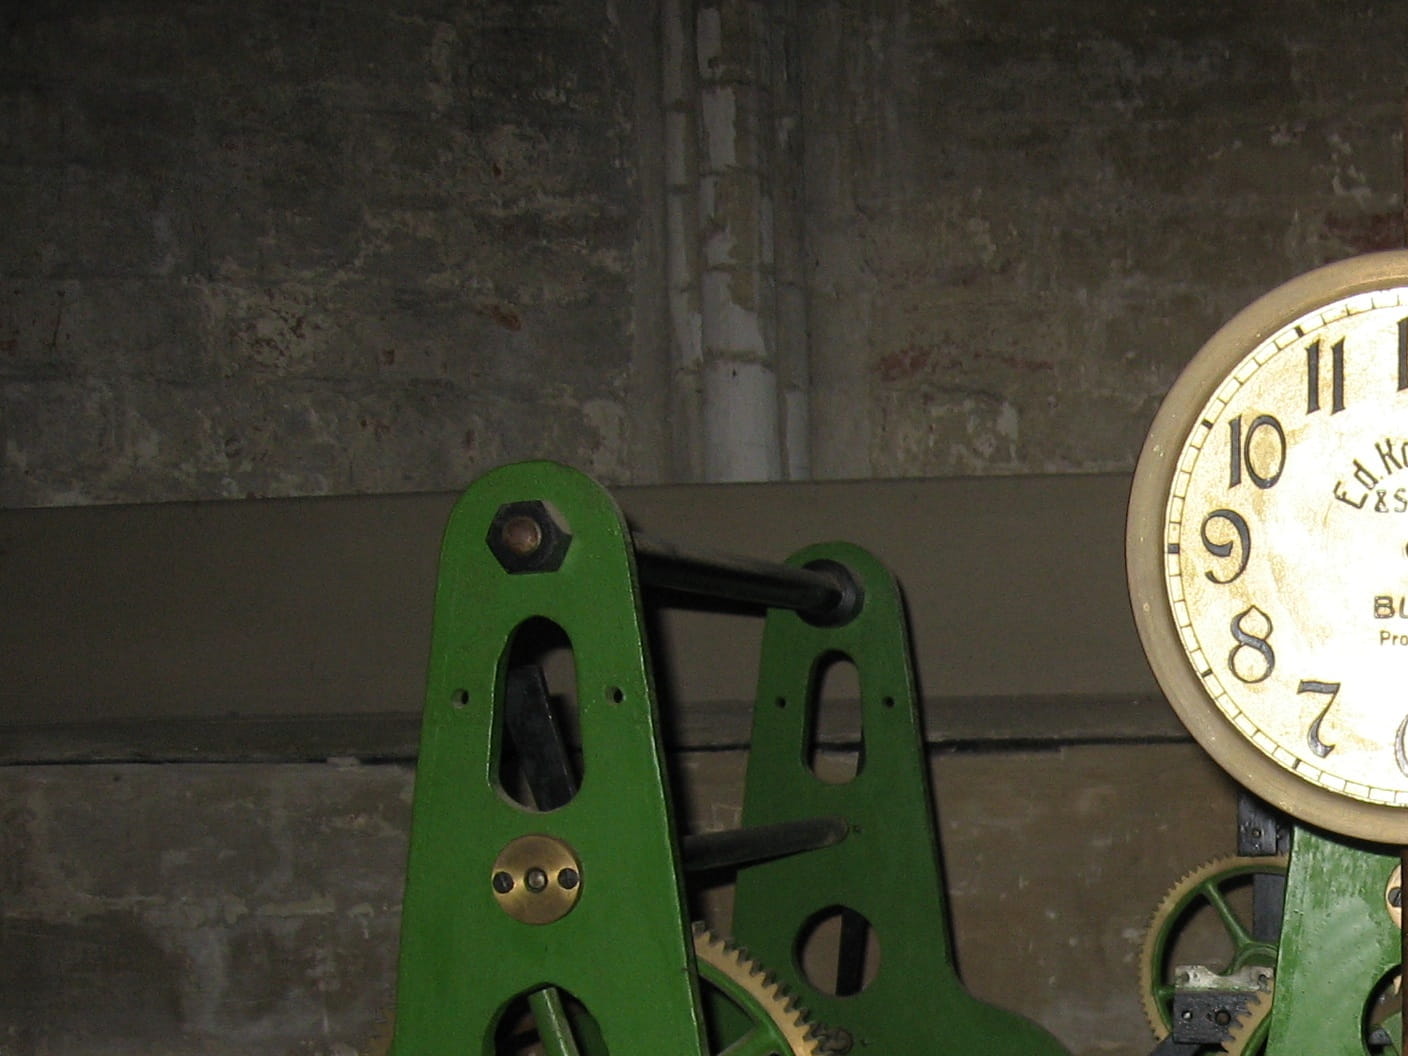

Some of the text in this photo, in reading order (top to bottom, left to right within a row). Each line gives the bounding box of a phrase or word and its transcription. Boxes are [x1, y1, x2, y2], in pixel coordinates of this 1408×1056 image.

[1304, 336, 1346, 416] 11
[1228, 413, 1287, 490] 10
[1333, 458, 1384, 510] Ed.
[1374, 489, 1389, 513] &
[1200, 508, 1251, 584] 9
[1227, 605, 1276, 684] 8
[1297, 680, 1341, 759] 7
